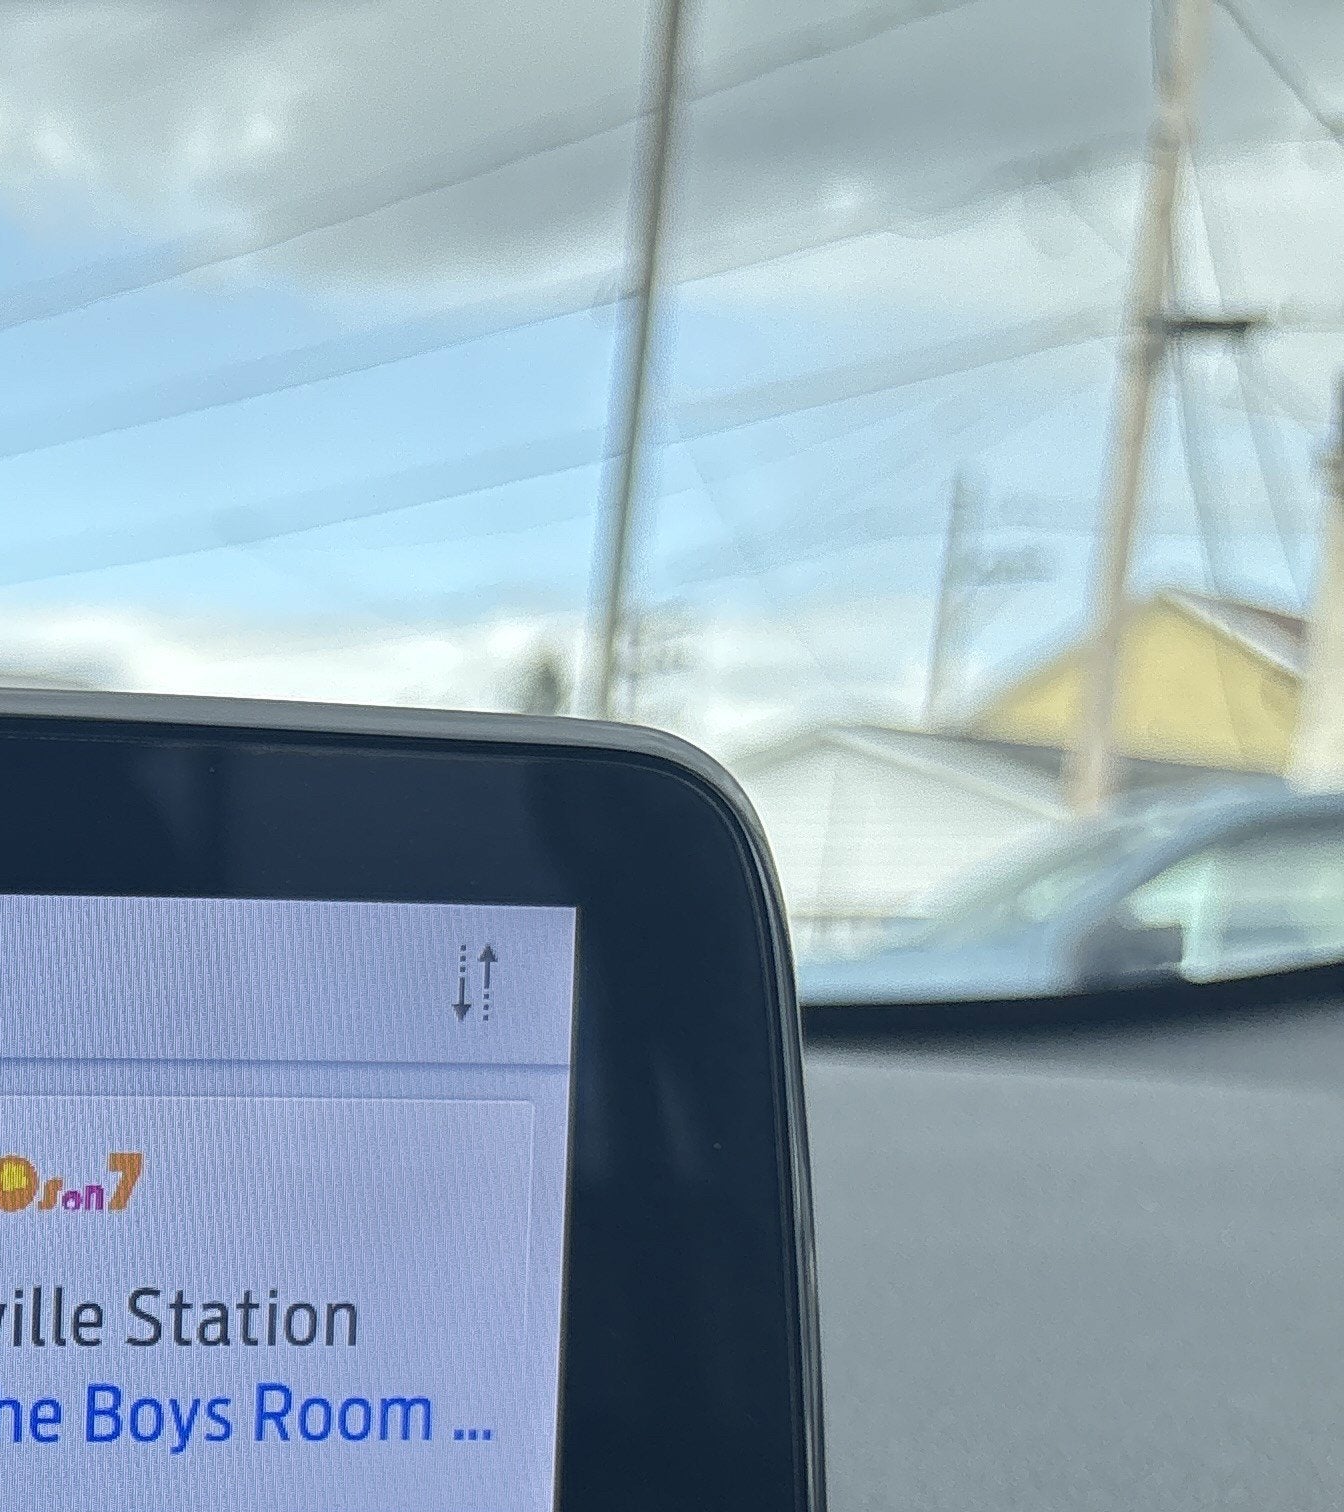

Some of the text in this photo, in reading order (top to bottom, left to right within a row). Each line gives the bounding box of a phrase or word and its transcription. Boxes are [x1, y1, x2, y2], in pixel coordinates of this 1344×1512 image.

[125, 1286, 360, 1348] Station
[85, 1382, 234, 1455] Boys
[254, 1382, 434, 1443] Room
